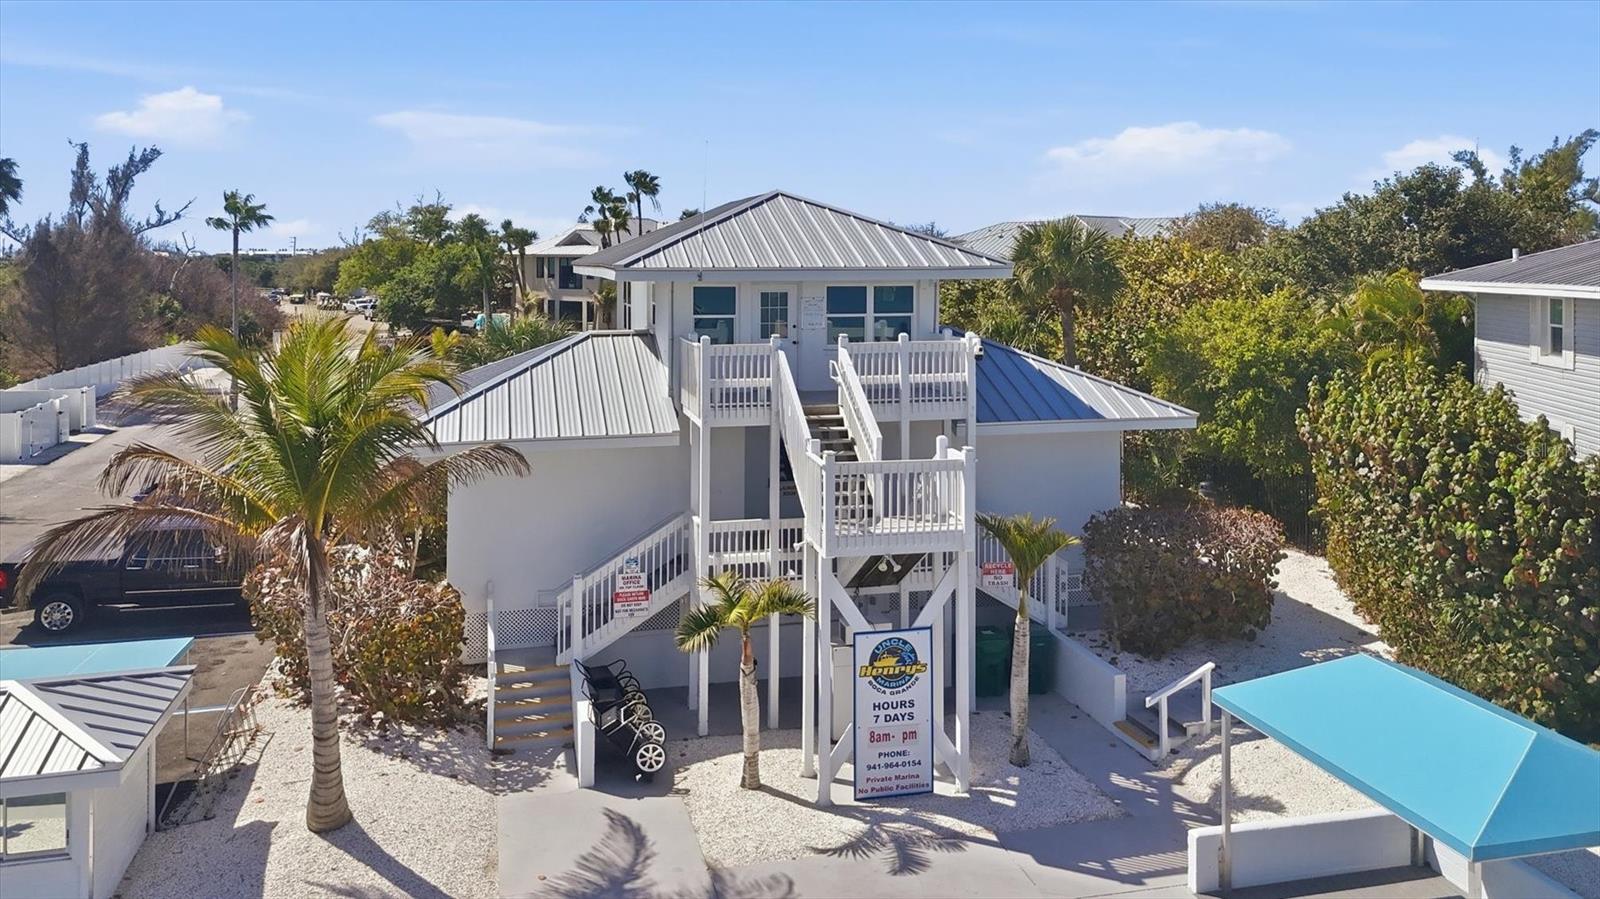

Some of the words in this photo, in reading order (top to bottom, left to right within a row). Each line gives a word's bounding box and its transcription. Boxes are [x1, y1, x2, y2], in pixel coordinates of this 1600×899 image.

[874, 638, 913, 654] UNCLE
[859, 660, 928, 678] Henry's
[867, 679, 887, 695] BOCA
[889, 675, 921, 696] GRANDE
[876, 675, 911, 688] MARINA
[872, 699, 915, 711] HOURS
[873, 714, 880, 724] 7
[884, 711, 914, 723] DAYS
[902, 730, 918, 744] pm
[878, 749, 910, 759] PHONE:
[866, 760, 922, 771] 941-964-0154
[866, 776, 893, 784] Private
[894, 773, 920, 781] Marina
[870, 785, 894, 793] Public
[895, 782, 930, 791] Facilities
